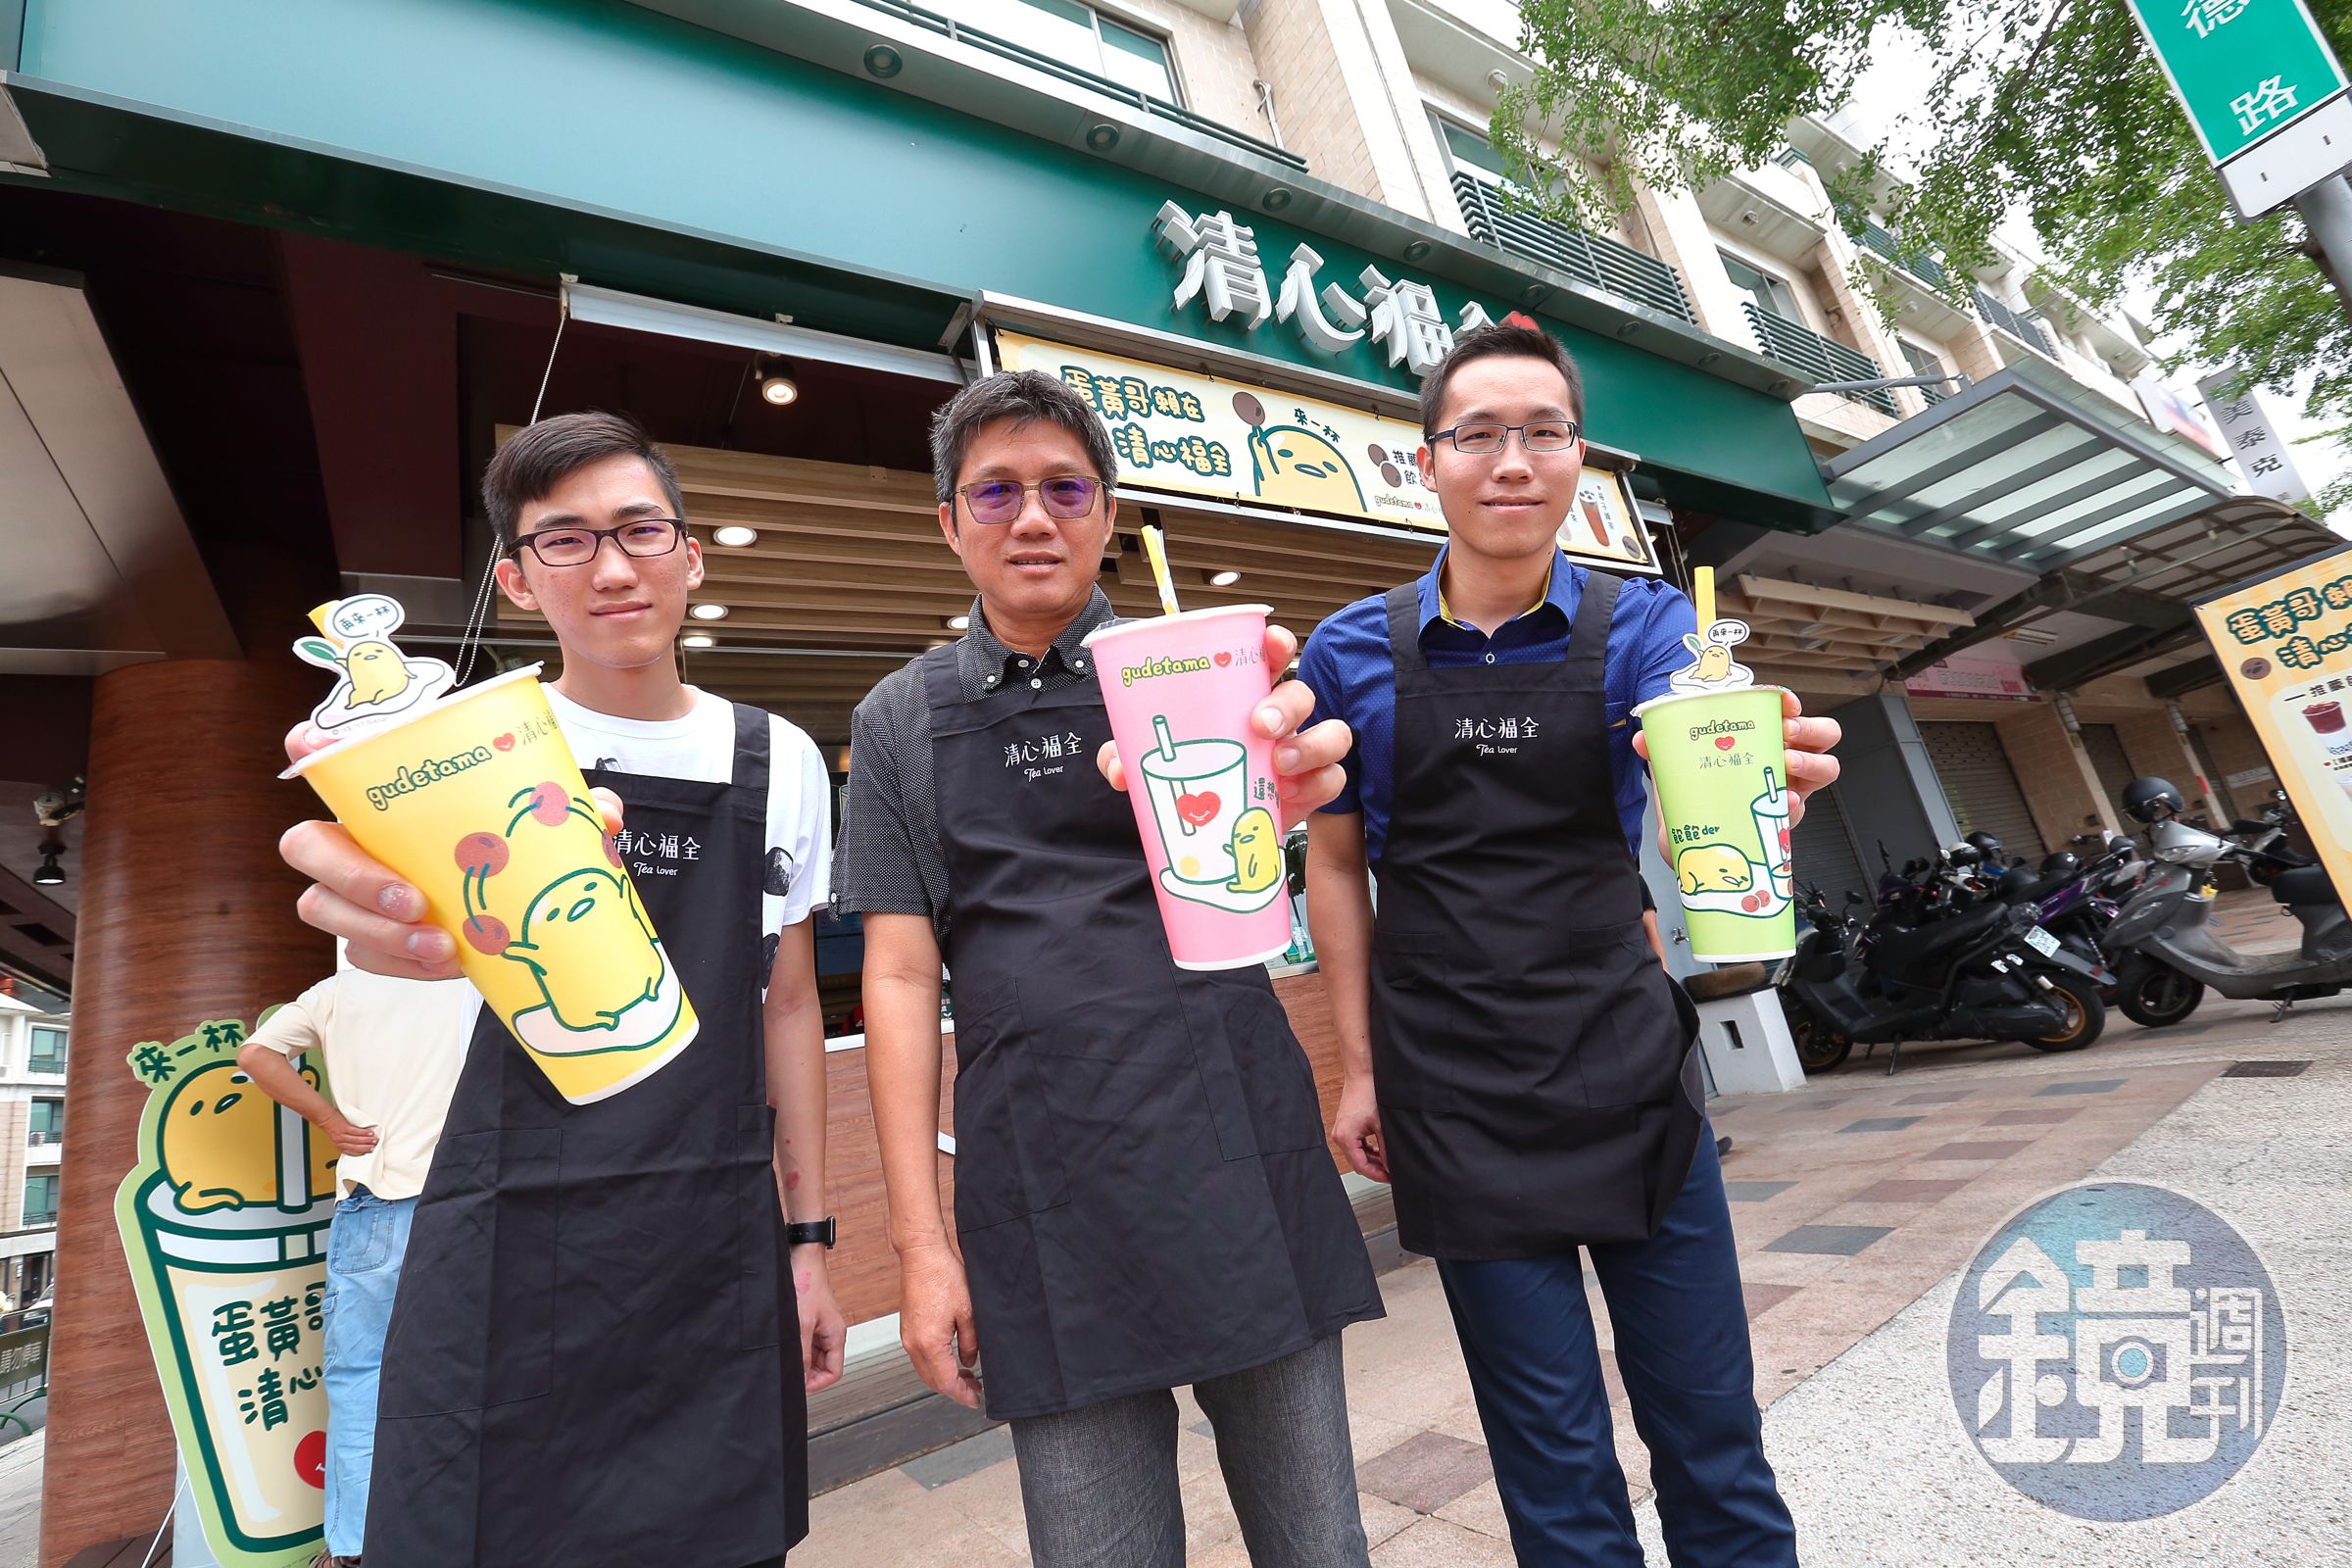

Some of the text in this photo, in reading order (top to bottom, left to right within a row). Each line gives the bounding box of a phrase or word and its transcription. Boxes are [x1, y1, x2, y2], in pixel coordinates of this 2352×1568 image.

[1060, 366, 1205, 423] 蛋黃哥賴在
[1294, 408, 1341, 443] 來一杯
[1111, 421, 1232, 477] 清心福全
[1374, 494, 1414, 510] gudetama
[339, 605, 390, 631] 再來一杯
[2276, 622, 2352, 669] 清心
[1121, 656, 1211, 687] gudetama
[1454, 716, 1540, 739] 清心福全
[1690, 719, 1755, 741] gudetama
[1004, 731, 1083, 768] 清心福全
[1476, 744, 1495, 757] Tea
[1700, 752, 1754, 769] 清心福全
[366, 745, 492, 811] gudetama
[1024, 767, 1042, 783] Tea
[612, 828, 702, 860] 清心福全
[633, 861, 655, 877] Tea
[134, 1023, 245, 1083] 來一杯
[237, 1366, 324, 1432] 清心
